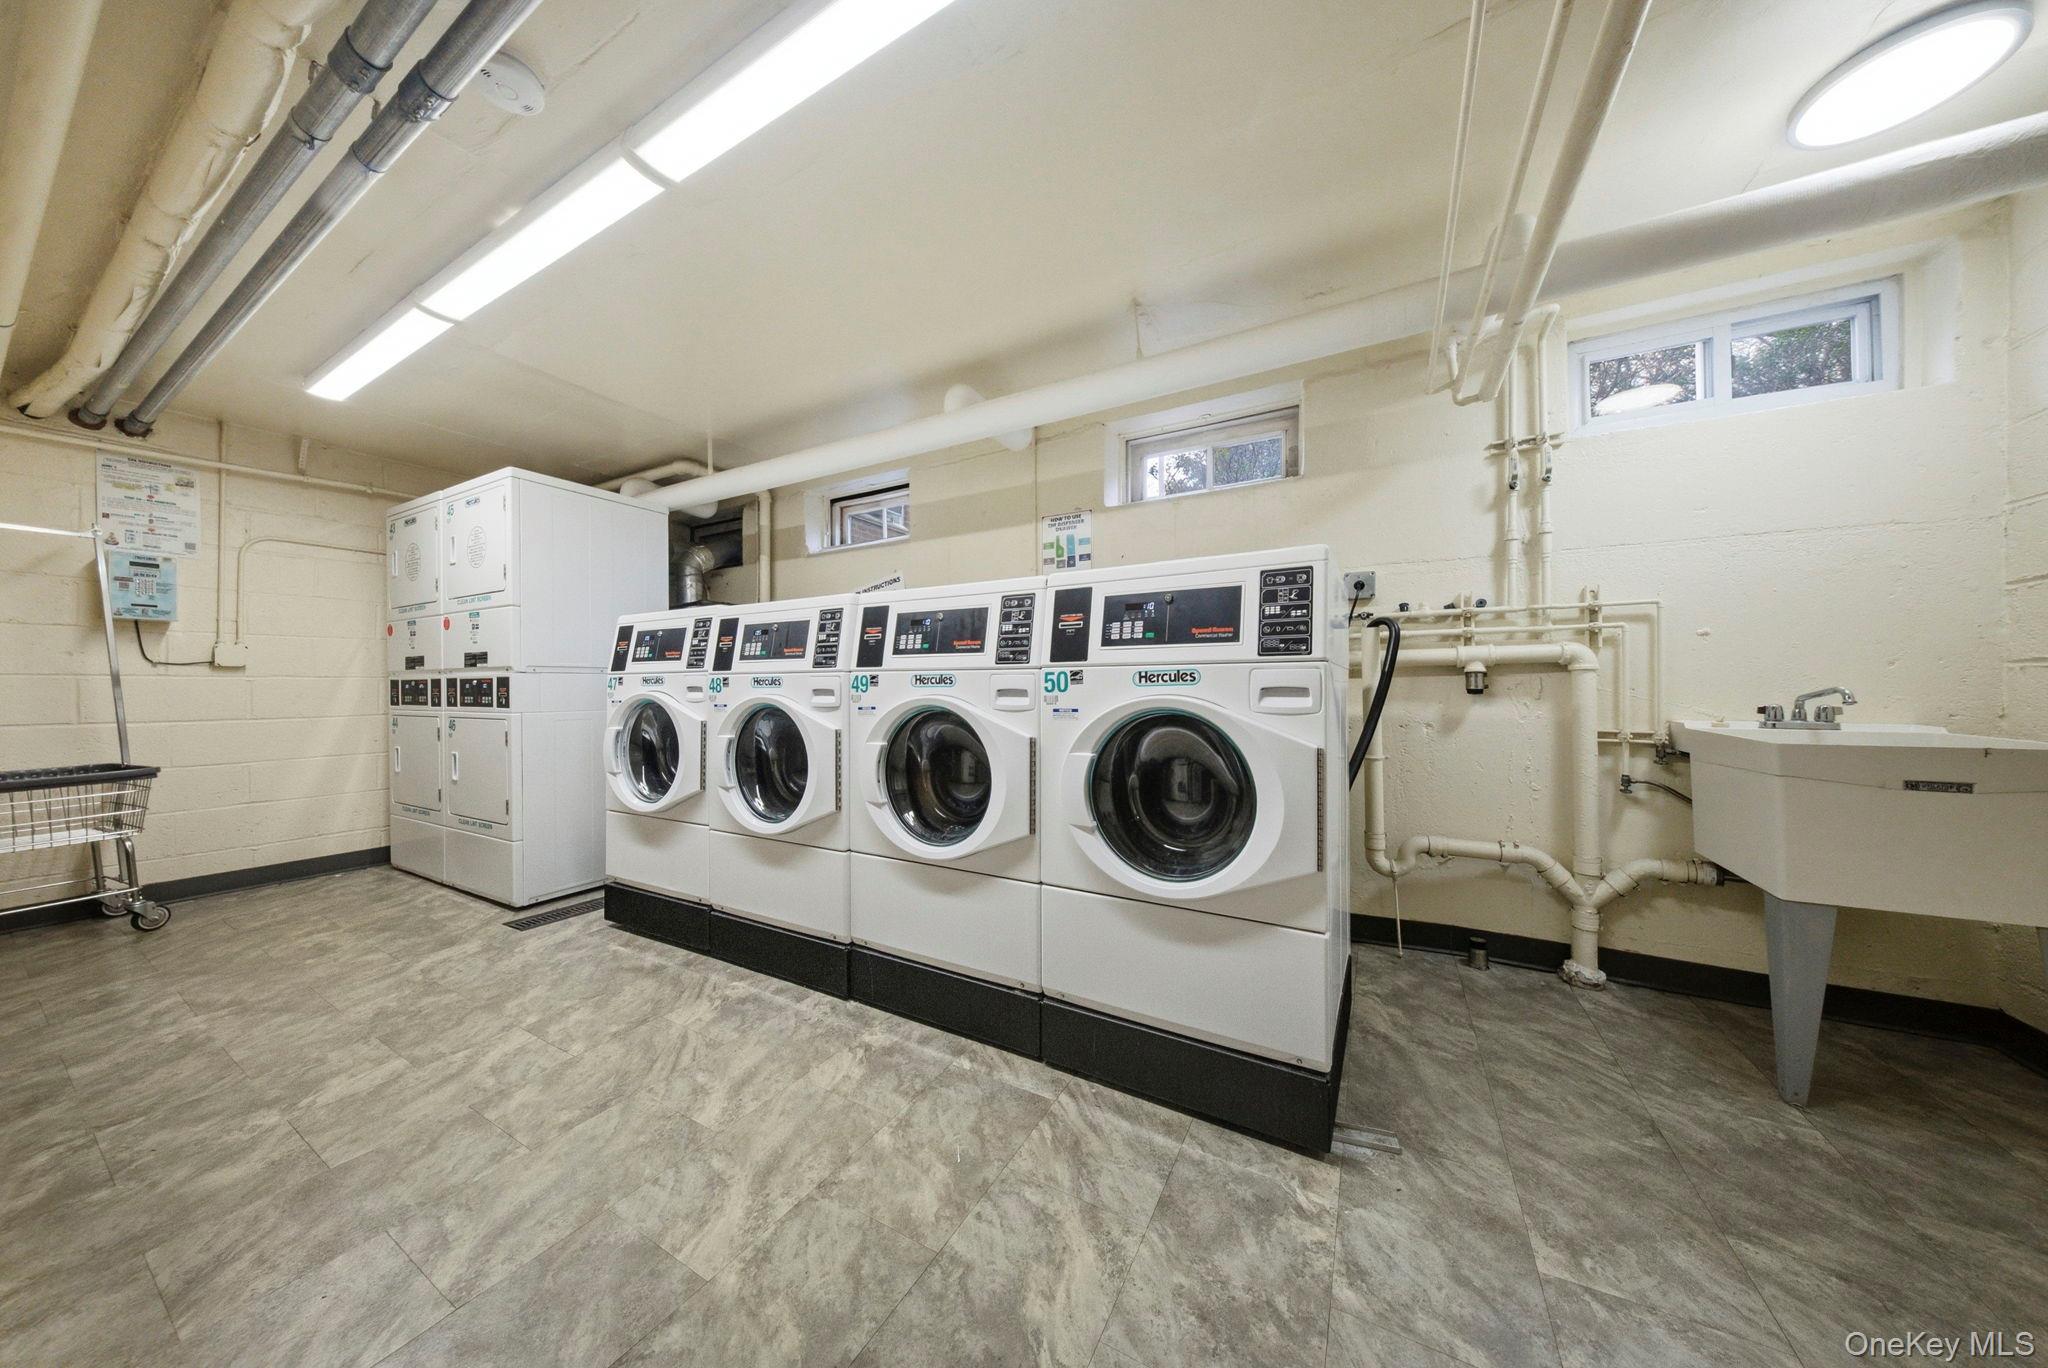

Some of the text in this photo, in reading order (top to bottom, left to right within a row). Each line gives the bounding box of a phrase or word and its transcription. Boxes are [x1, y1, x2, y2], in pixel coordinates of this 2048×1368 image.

[861, 576, 901, 593] INSTRUCTIONS
[607, 677, 617, 690] 47
[642, 676, 664, 685] Hercules
[753, 677, 782, 687] Hercules
[851, 674, 869, 693] 49
[914, 673, 954, 685] Hercules
[1044, 671, 1069, 693] 50
[1138, 669, 1197, 684] Hercules
[709, 677, 722, 693] 48
[458, 818, 469, 826] CLEAN
[478, 821, 493, 830] SCREEN
